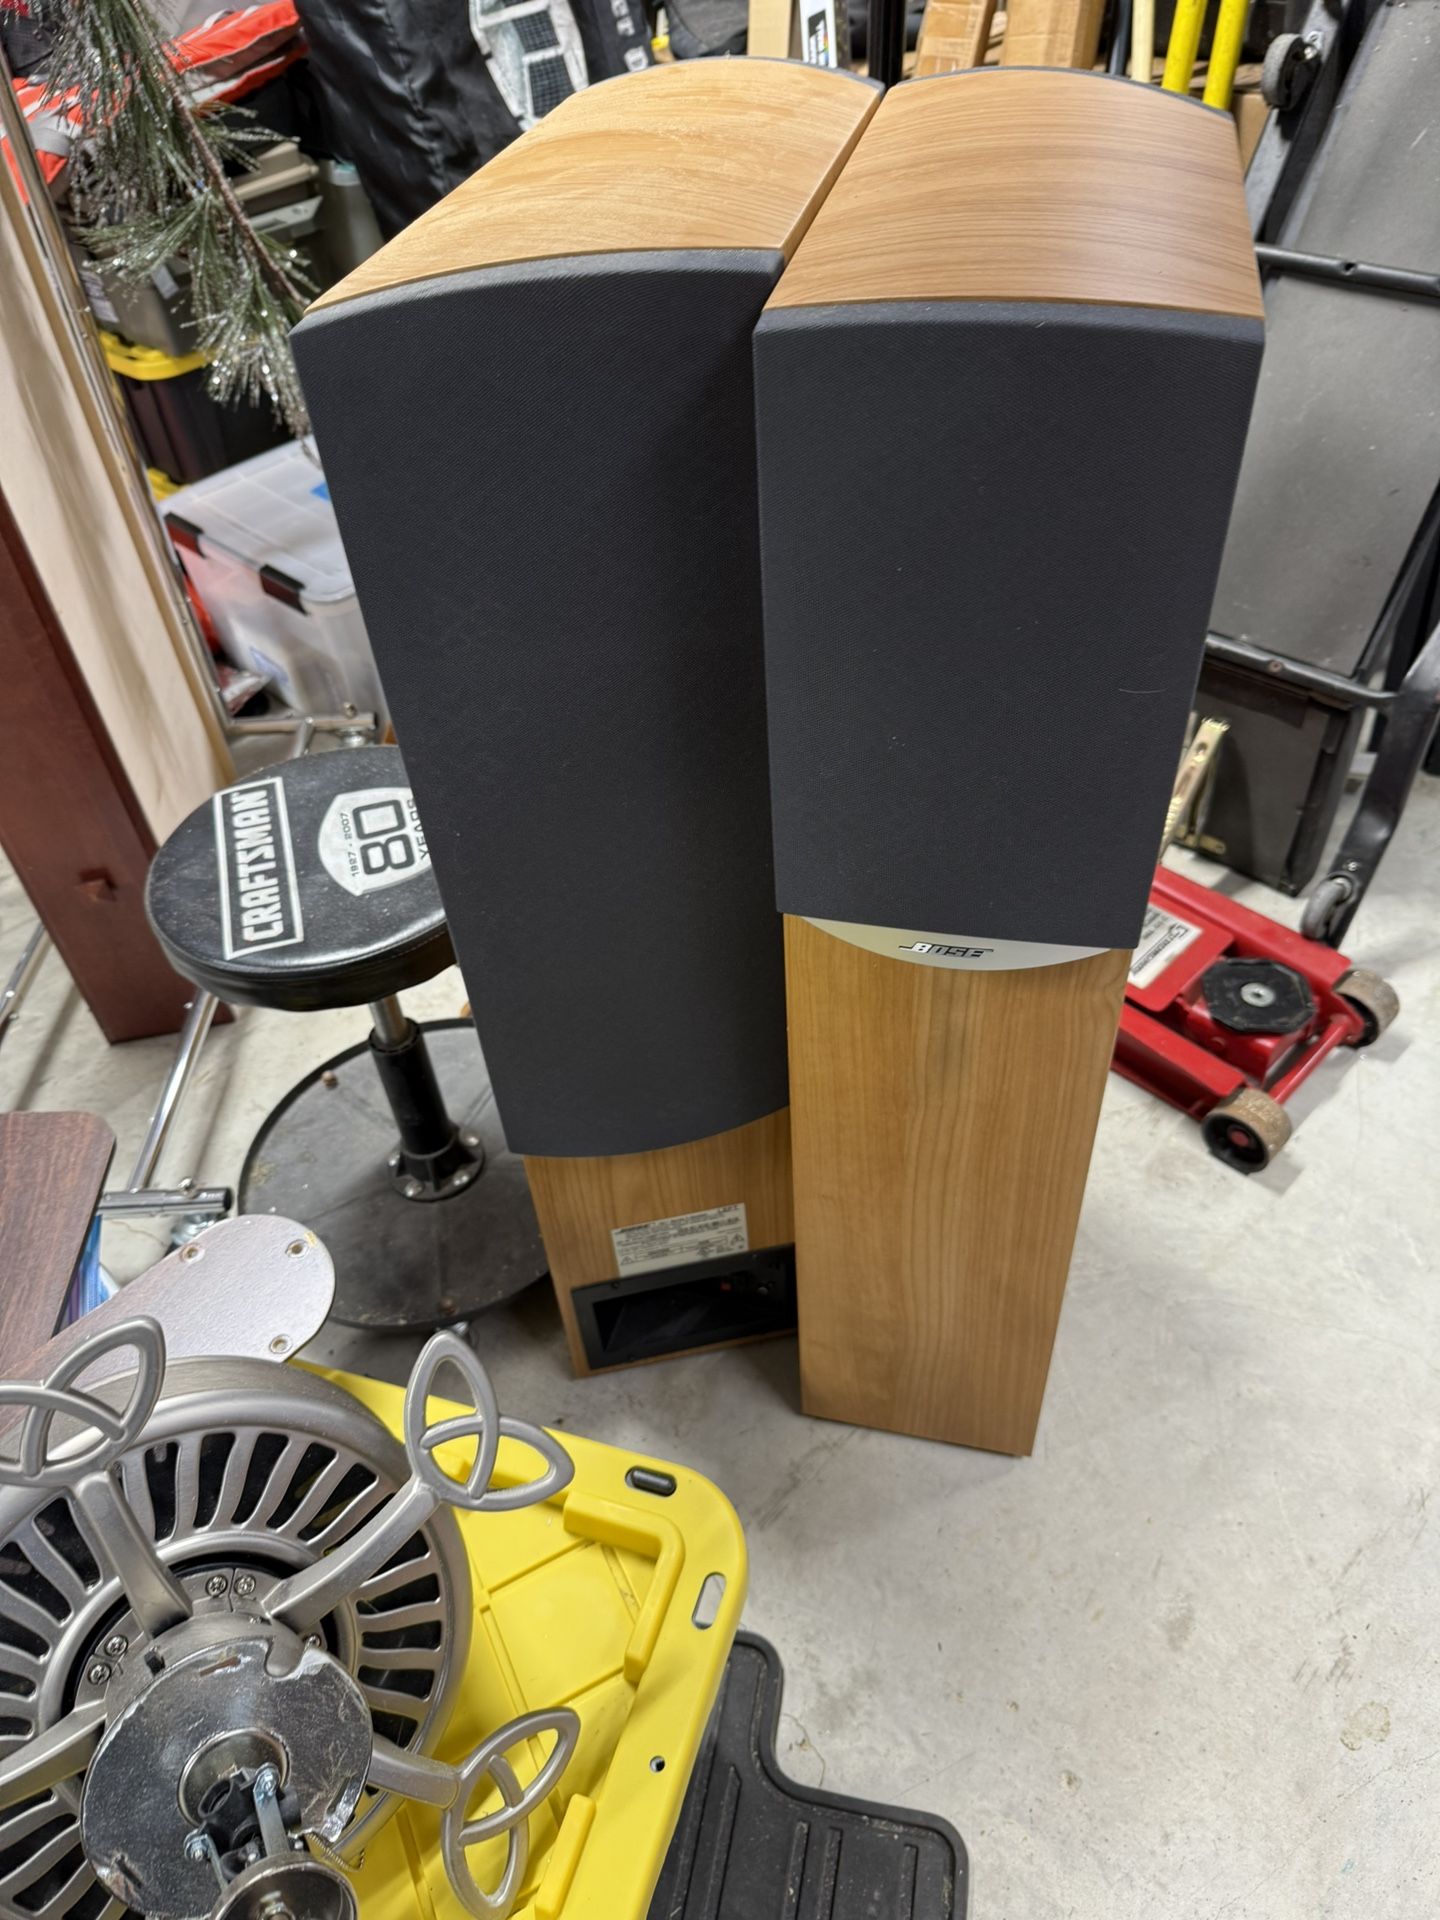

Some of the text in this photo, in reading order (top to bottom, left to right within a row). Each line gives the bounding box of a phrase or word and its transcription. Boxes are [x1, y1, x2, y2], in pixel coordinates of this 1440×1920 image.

[340, 812, 353, 840] 2007
[352, 799, 415, 875] 80
[231, 789, 284, 942] CRAFTSMAN
[347, 851, 360, 877] 1927
[900, 941, 993, 958] BOSE
